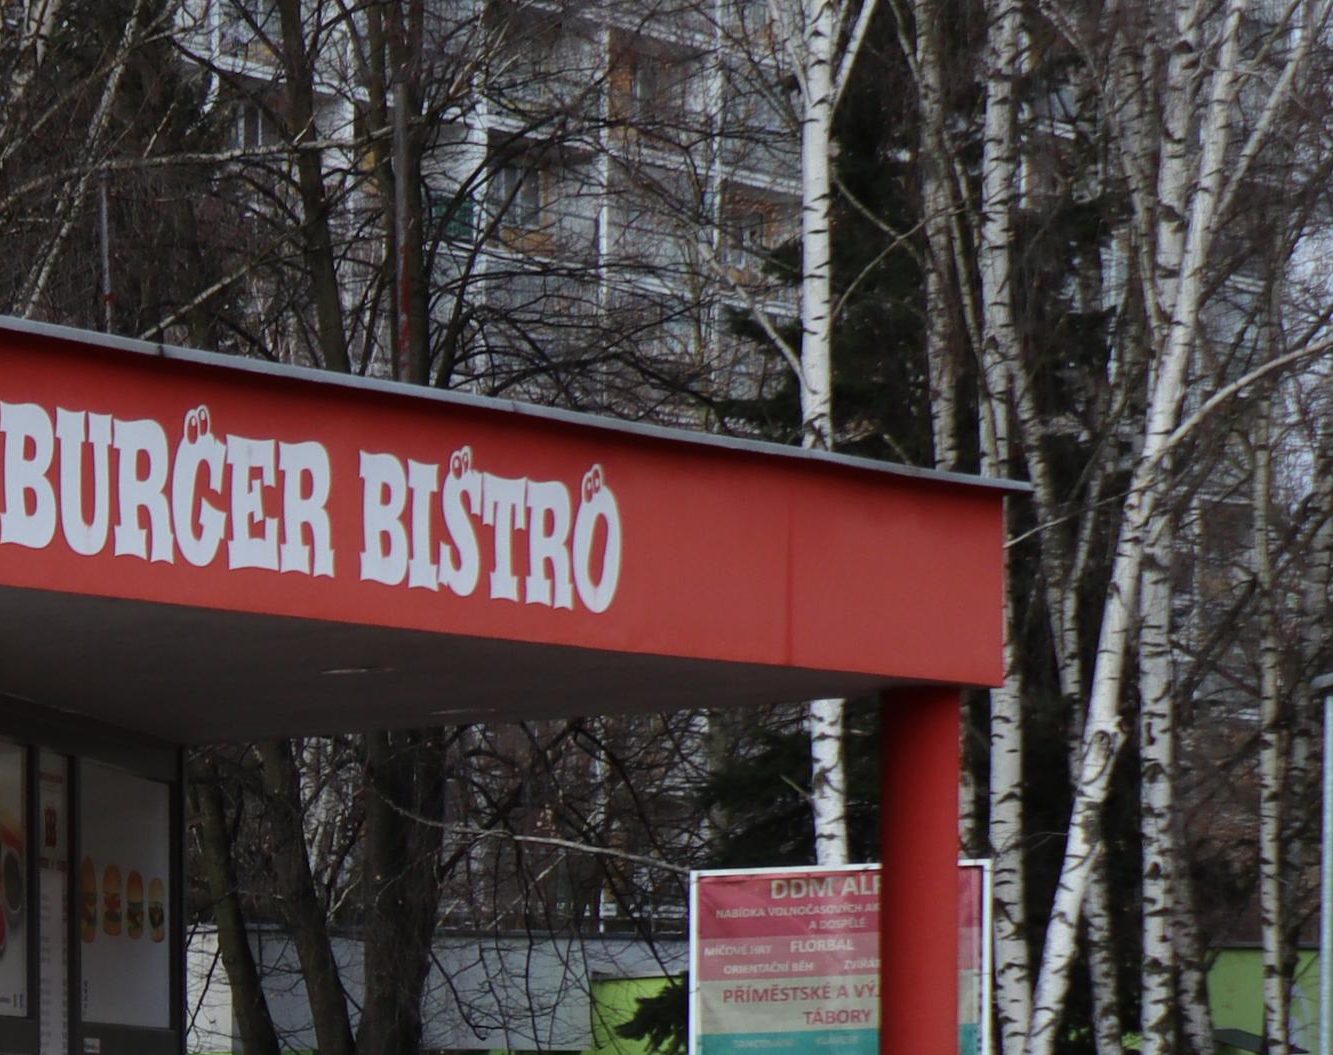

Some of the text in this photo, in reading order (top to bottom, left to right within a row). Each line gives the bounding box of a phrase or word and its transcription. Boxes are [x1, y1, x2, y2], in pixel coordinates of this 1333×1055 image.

[0, 386, 334, 579] BURGER
[359, 446, 622, 614] BISTRO
[771, 875, 881, 899] DDM ALF
[715, 906, 765, 919] NABÍDKA
[790, 938, 854, 953] FLORBAL
[723, 981, 881, 1003] PŘÍMĚSTSKÉ A VÝ
[803, 1007, 872, 1025] TÁBORY
